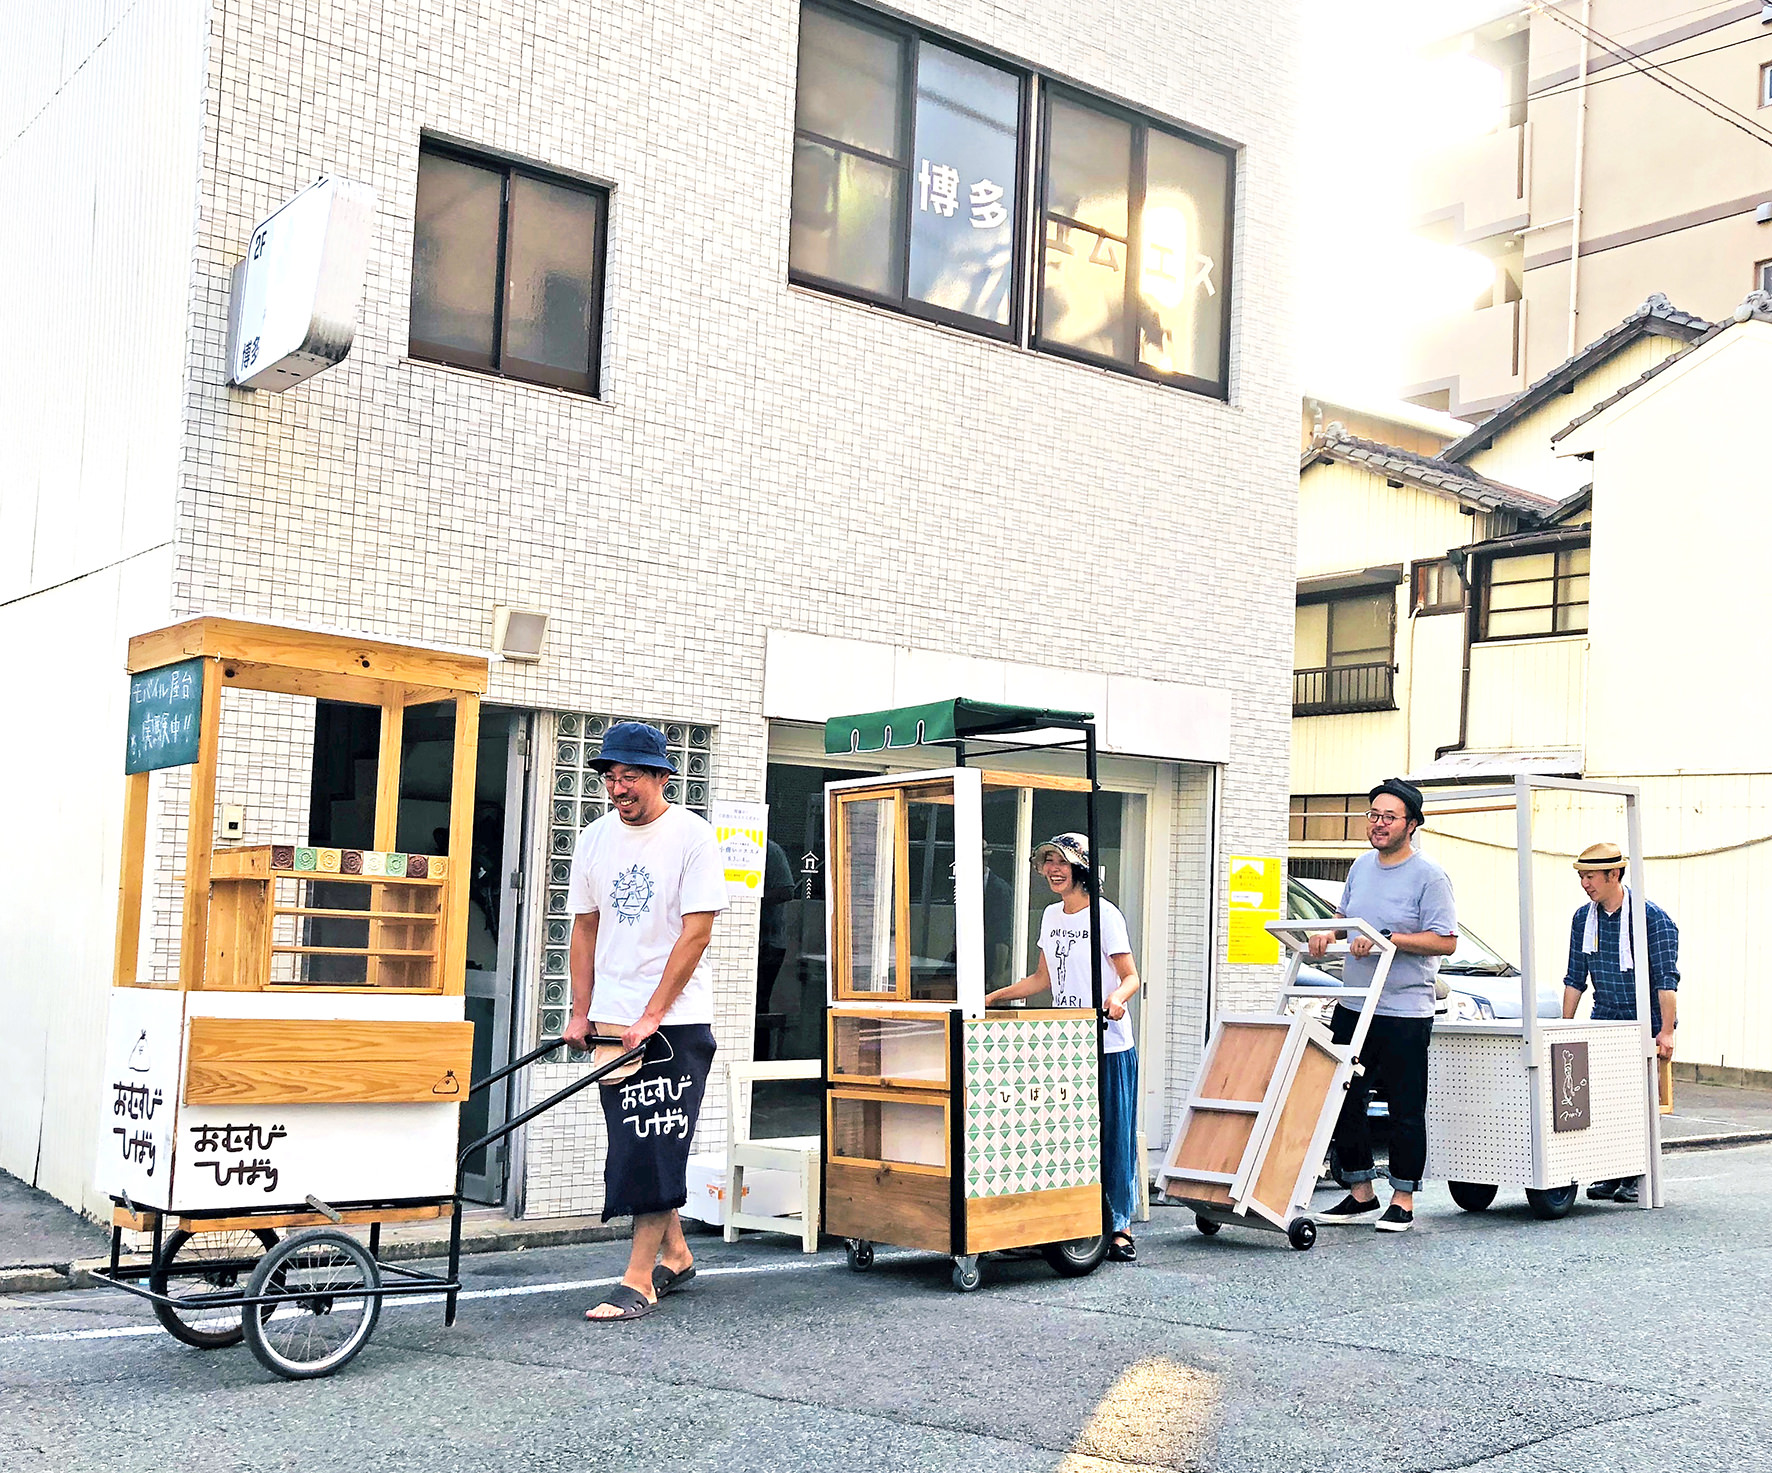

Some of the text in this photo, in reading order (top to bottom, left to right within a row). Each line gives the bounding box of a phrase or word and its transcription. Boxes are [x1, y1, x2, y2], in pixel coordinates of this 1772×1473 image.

[917, 157, 1009, 230] 博多
[253, 230, 268, 261] 2F
[132, 670, 193, 705] モバイル屋台
[1050, 927, 1090, 940] OMUSUB
[113, 1080, 163, 1120] おむすび
[619, 1074, 693, 1111] おむすび
[999, 1087, 1067, 1103] ひばり
[190, 1123, 287, 1153] おむすび
[622, 1107, 690, 1140] ひばり
[113, 1127, 156, 1177] ひばり
[193, 1159, 279, 1192] ひばり
